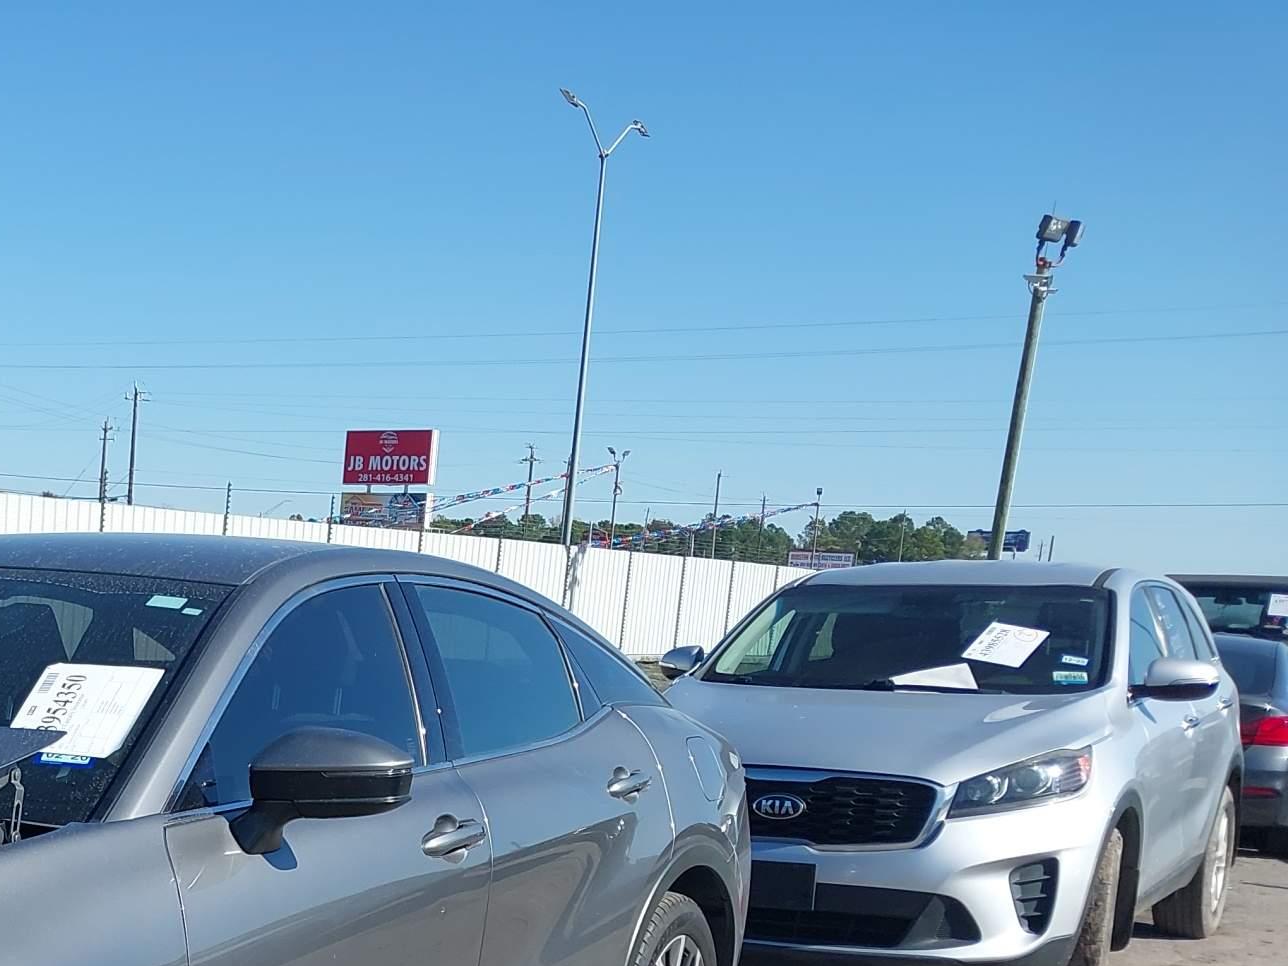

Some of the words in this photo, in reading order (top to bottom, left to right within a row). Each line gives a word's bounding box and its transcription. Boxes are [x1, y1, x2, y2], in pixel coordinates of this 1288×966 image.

[348, 455, 364, 471] JB
[368, 455, 427, 471] MOTORS
[358, 473, 414, 482] 281-416-4341
[760, 799, 794, 815] KIA
